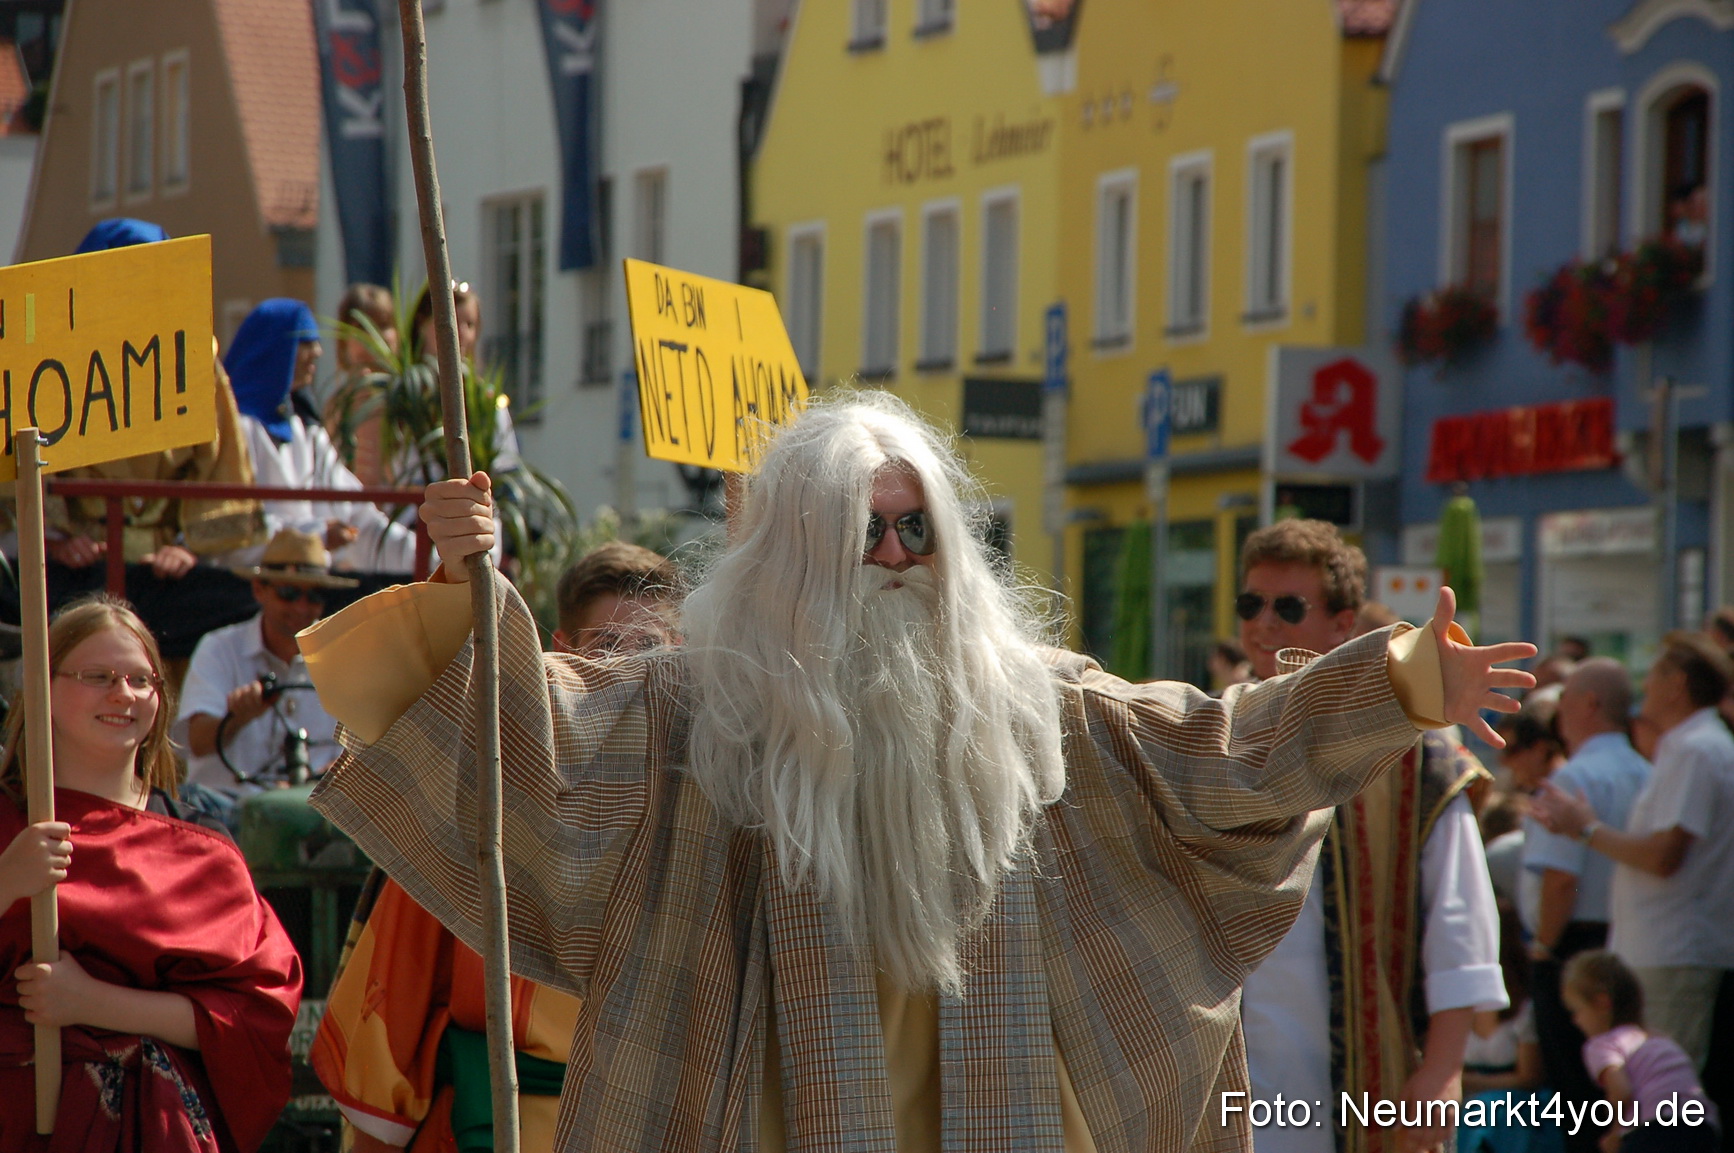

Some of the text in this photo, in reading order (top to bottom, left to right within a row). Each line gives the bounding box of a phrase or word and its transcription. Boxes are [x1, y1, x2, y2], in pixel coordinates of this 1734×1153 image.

[881, 114, 956, 187] HOTEL
[654, 272, 678, 324] DA
[682, 282, 707, 331] BIN
